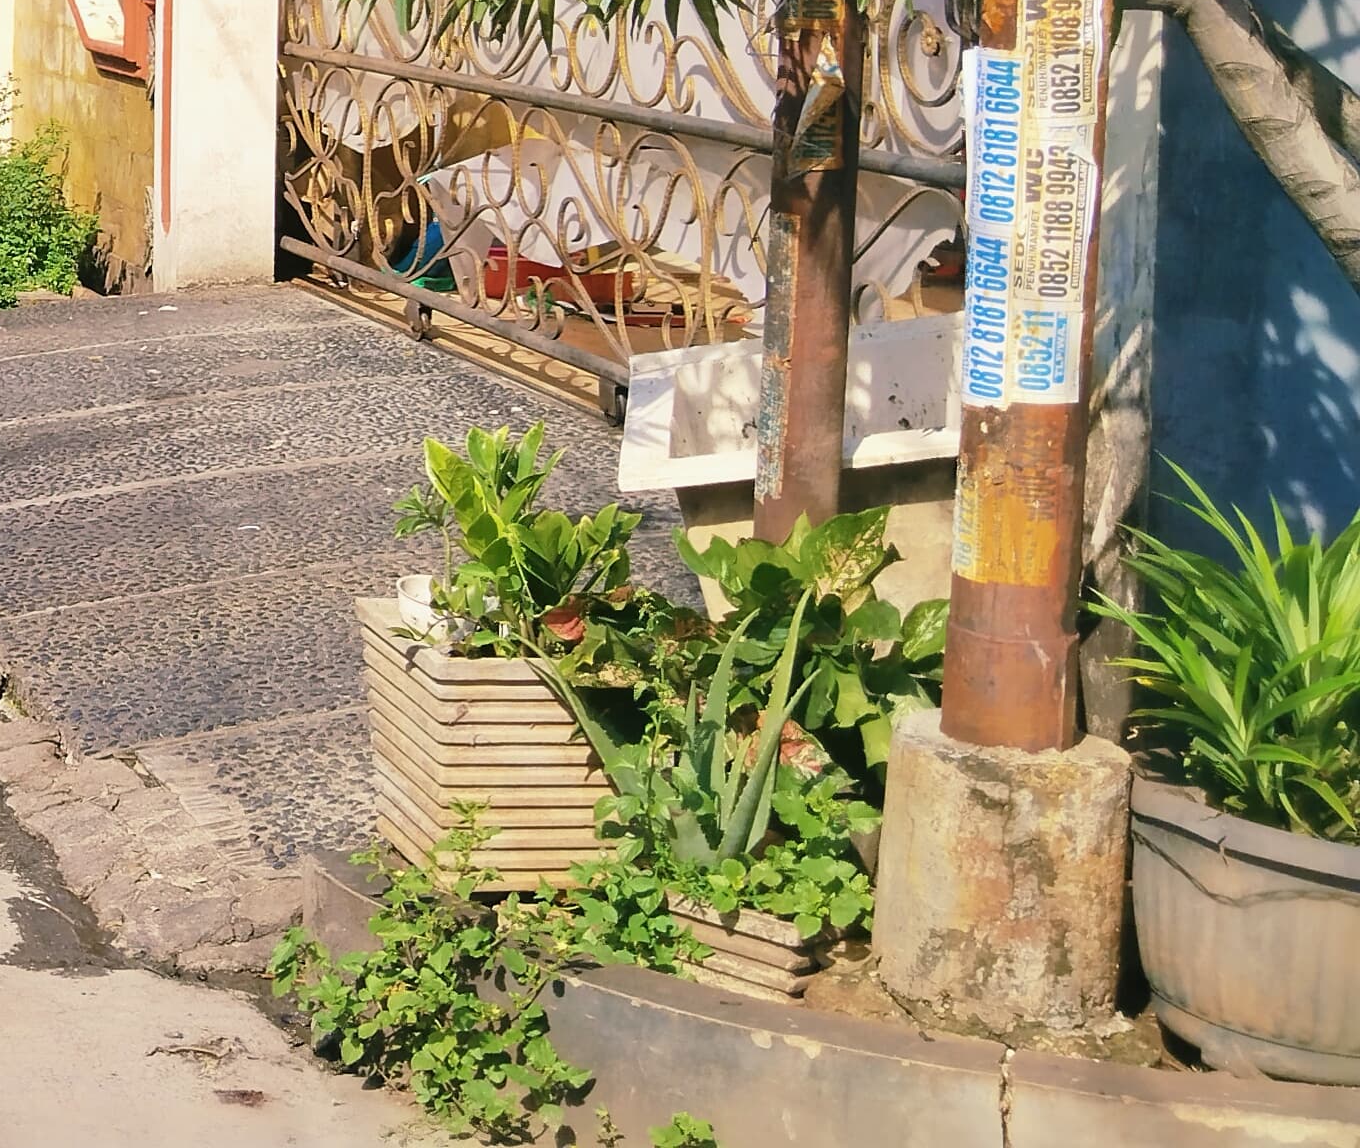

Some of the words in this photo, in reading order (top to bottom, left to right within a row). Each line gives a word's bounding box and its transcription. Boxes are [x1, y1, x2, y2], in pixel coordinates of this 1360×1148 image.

[1051, 18, 1081, 59] 1188
[984, 60, 1021, 114] 6644
[1051, 63, 1081, 114] 0852
[981, 118, 1018, 167] 8181
[1024, 147, 1044, 204] WC
[1044, 145, 1077, 195] 9943
[1076, 159, 1088, 208] GEMILAN
[979, 169, 1015, 223] 0812
[1041, 200, 1074, 244] 1188
[973, 235, 1009, 291] 6644
[1026, 209, 1039, 290] PENUH/MAMPET
[1037, 248, 1070, 298] 0852
[971, 294, 1007, 344] 8181
[969, 346, 1004, 399] 0812
[1017, 336, 1053, 391] 0852
